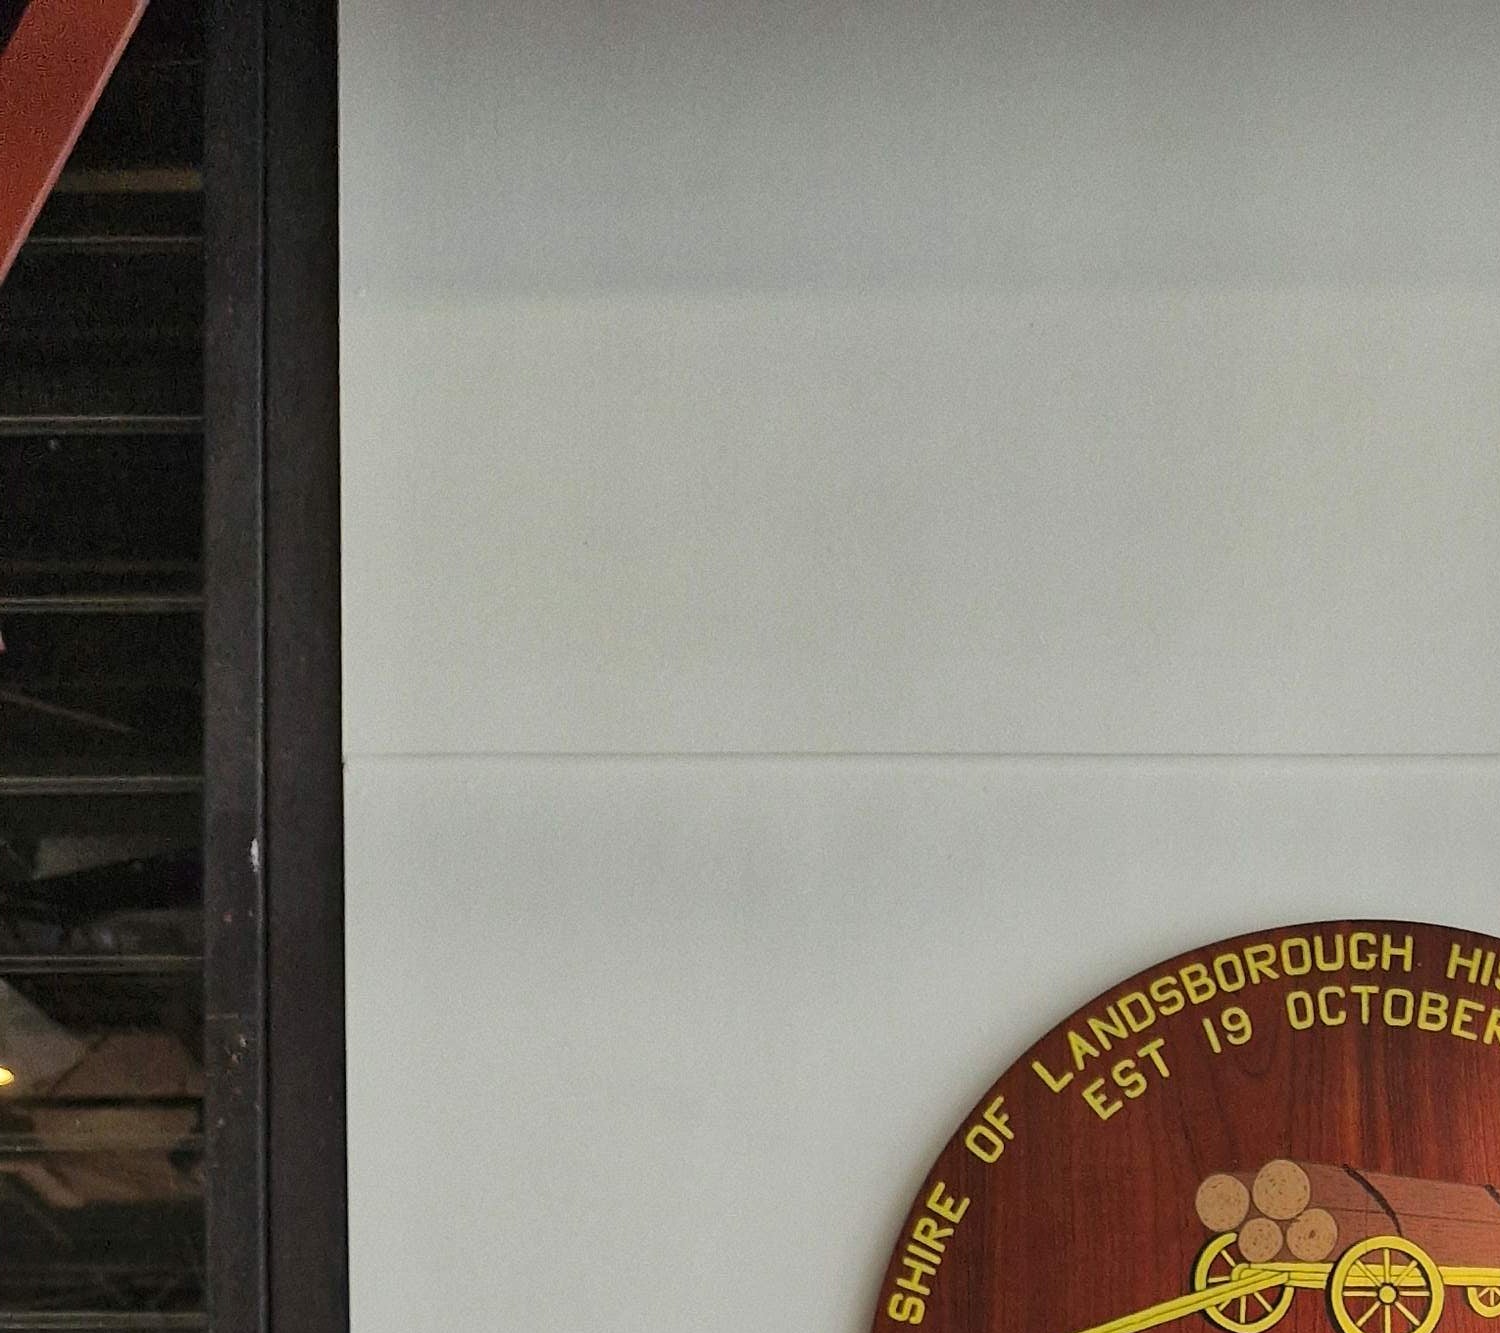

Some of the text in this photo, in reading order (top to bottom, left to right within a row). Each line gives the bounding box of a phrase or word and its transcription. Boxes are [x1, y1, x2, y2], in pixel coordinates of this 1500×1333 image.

[888, 1180, 969, 1325] SHIRE
[966, 1096, 1015, 1163] OF
[1032, 932, 1415, 1095] LANDSBOROUGH
[1081, 1040, 1171, 1121] EST
[1204, 1006, 1252, 1053] 19
